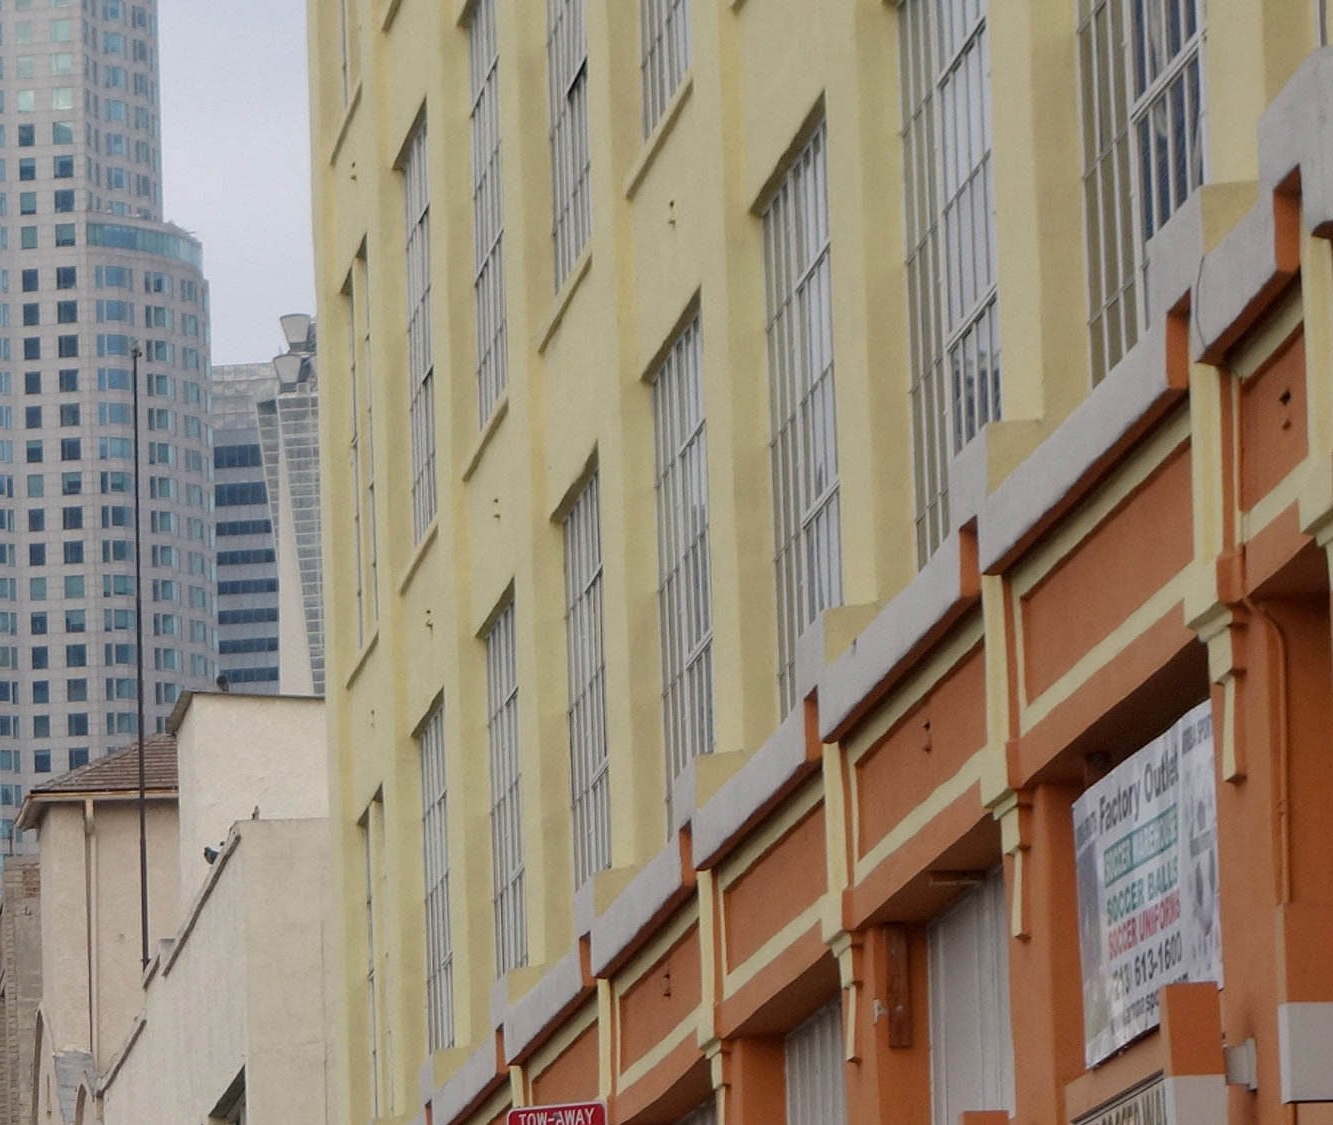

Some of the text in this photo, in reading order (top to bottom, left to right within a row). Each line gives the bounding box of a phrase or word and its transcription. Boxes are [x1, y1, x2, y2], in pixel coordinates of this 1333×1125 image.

[1099, 776, 1141, 836] Factory
[1144, 744, 1179, 803] Outlet
[1105, 838, 1132, 883] SOCCER
[1132, 809, 1178, 862] WAREHOUSE
[1107, 855, 1179, 926] SOCCER BALLS
[1108, 889, 1181, 961] SOCCER UNIFORMS
[1134, 930, 1182, 986] 613-1600
